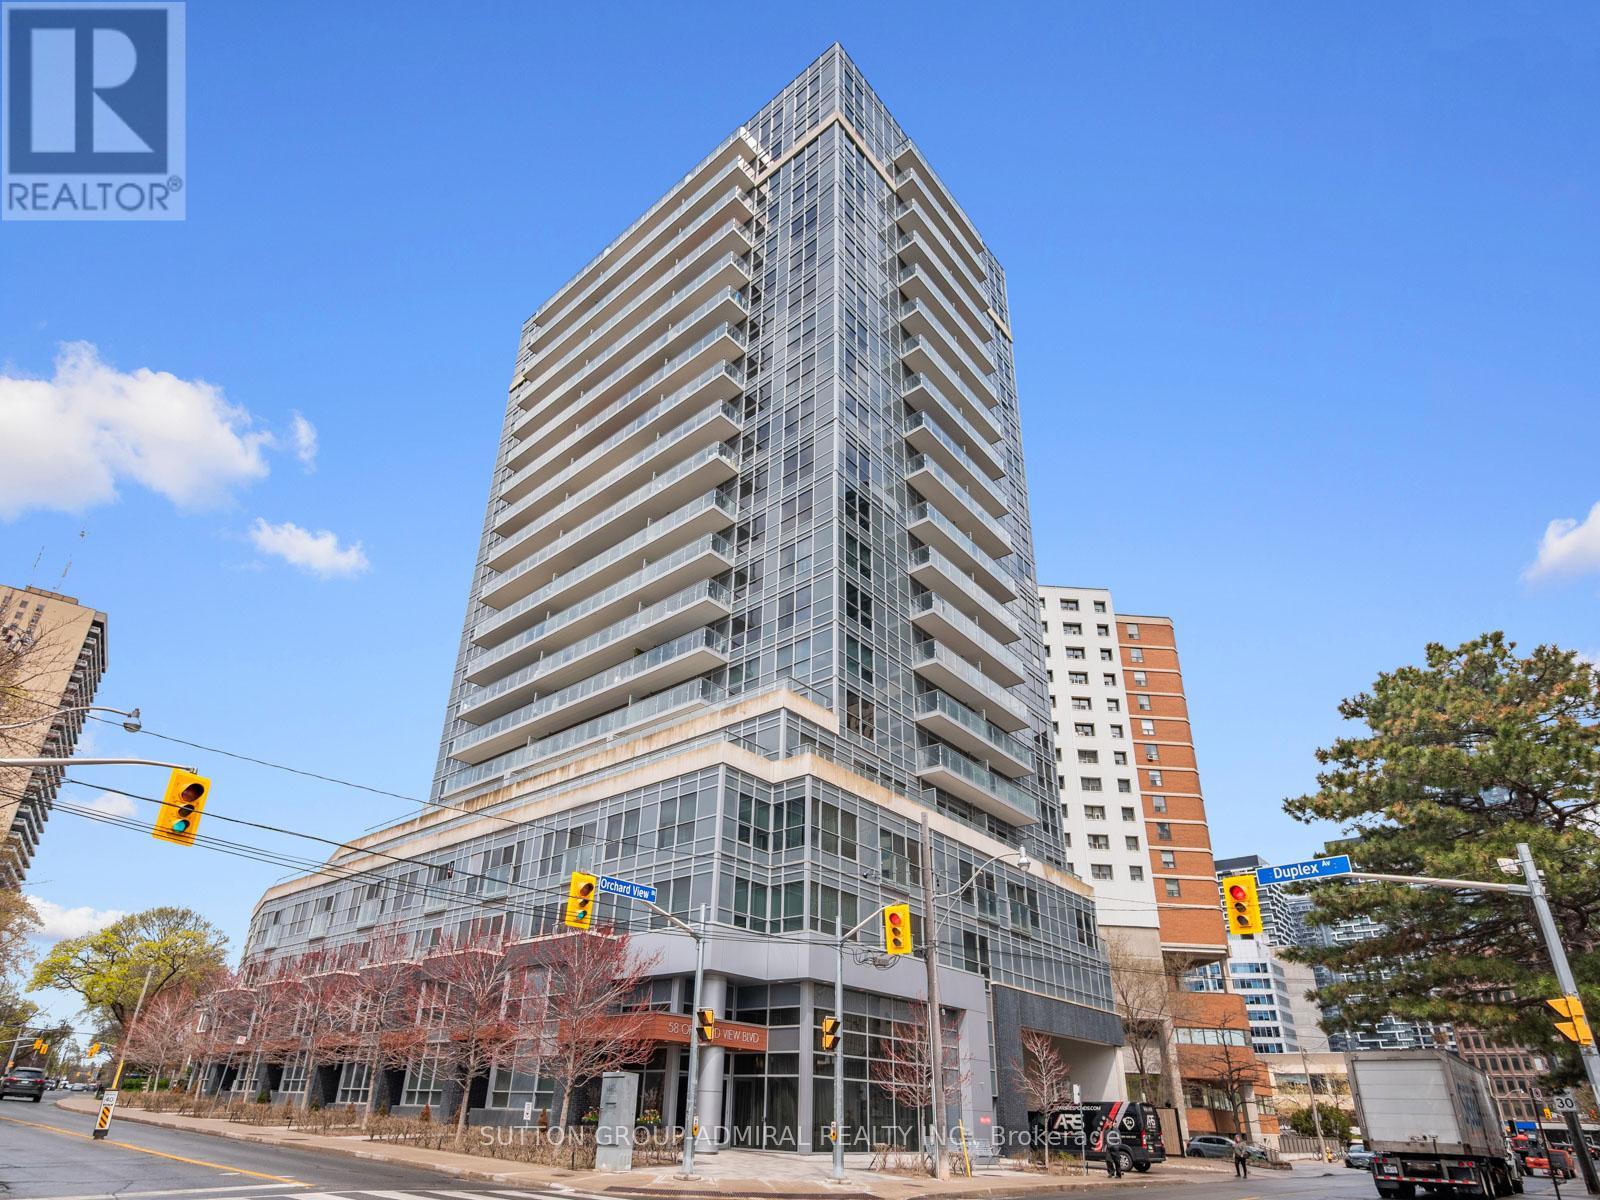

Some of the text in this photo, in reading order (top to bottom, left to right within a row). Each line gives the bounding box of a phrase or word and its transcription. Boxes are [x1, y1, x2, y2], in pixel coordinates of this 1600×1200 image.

[1273, 864, 1319, 879] Duplex
[600, 878, 631, 894] Orchard
[633, 885, 650, 898] View
[667, 1022, 679, 1034] 58
[723, 1029, 740, 1041] VIEW
[742, 1031, 760, 1043] BLVD
[1556, 1098, 1574, 1108] 30
[1053, 1113, 1085, 1130] ARS
